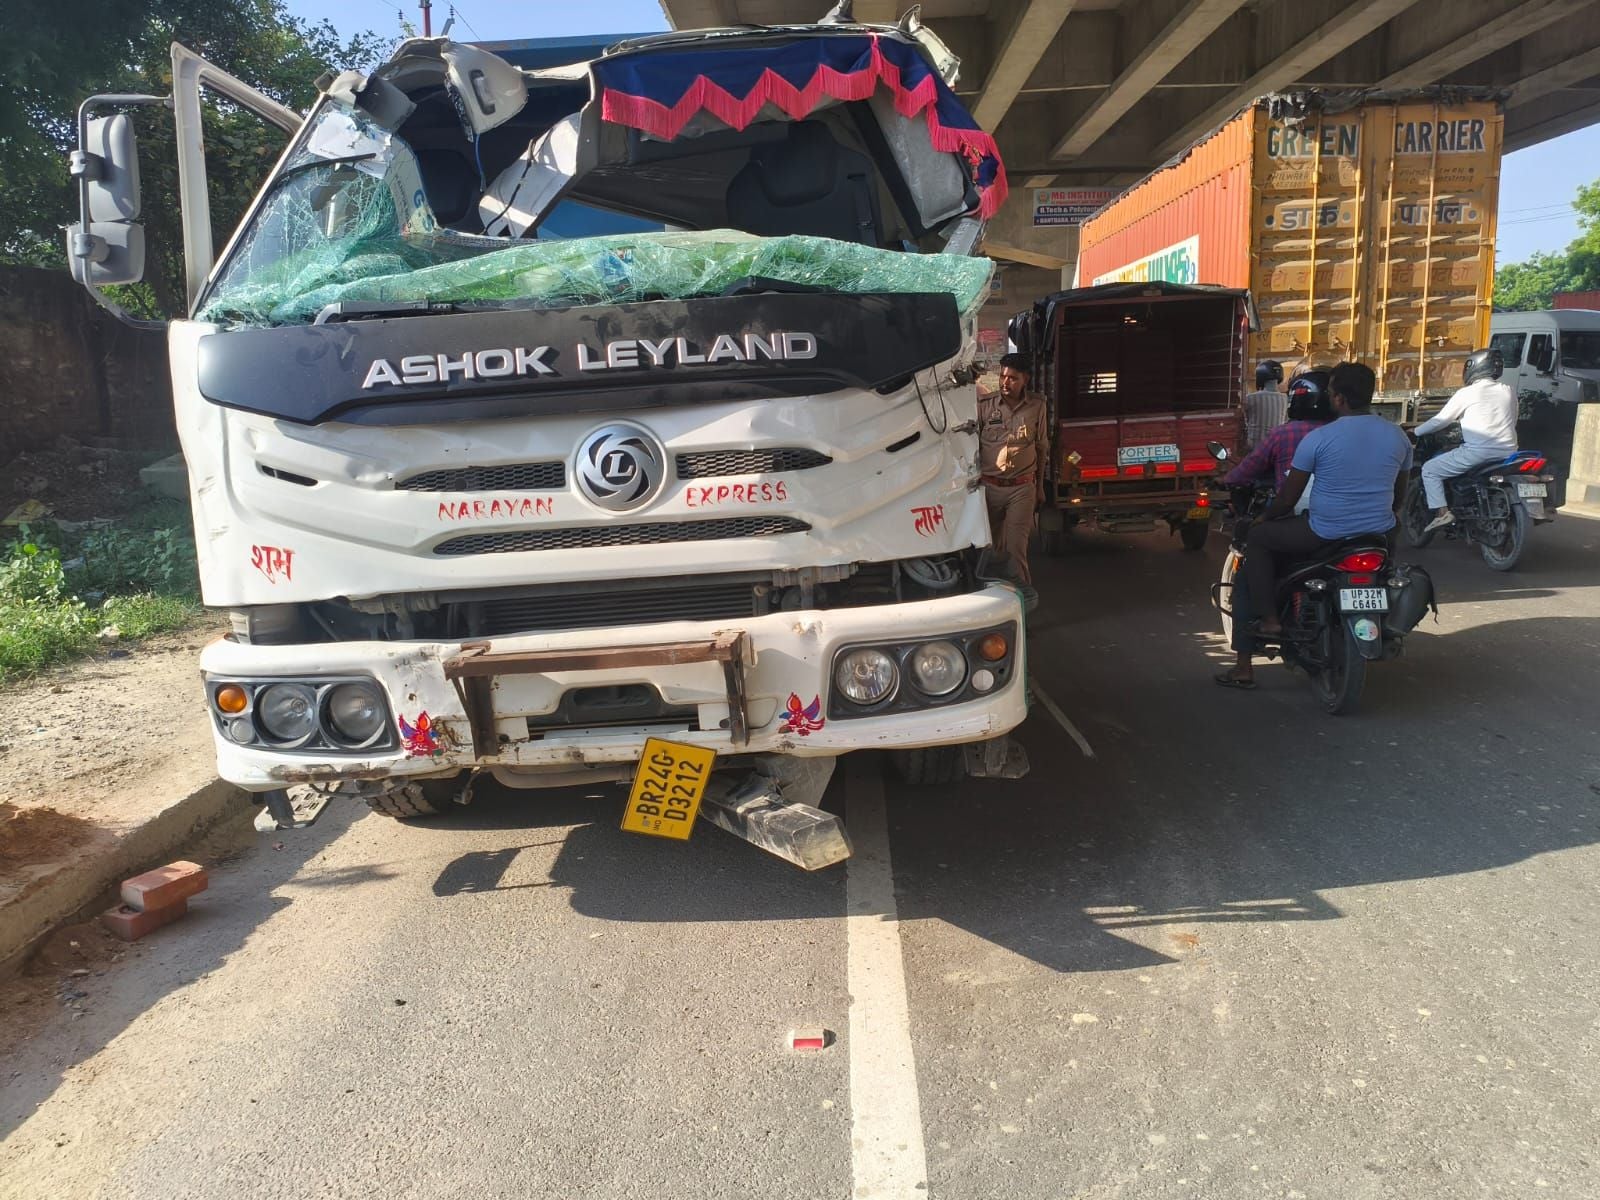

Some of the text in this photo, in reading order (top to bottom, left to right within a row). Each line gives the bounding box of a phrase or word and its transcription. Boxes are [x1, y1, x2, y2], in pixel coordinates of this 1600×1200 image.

[1267, 119, 1484, 157] GREEN CARRIER
[1280, 206, 1338, 229] डाक
[361, 331, 818, 390] ASHOK LEYLAND
[1119, 445, 1171, 458] PORTER
[437, 480, 788, 521] NARAYAN EXPRESS
[1352, 599, 1383, 609] C6461
[636, 752, 675, 816] BR24G
[663, 760, 704, 822] D3212
